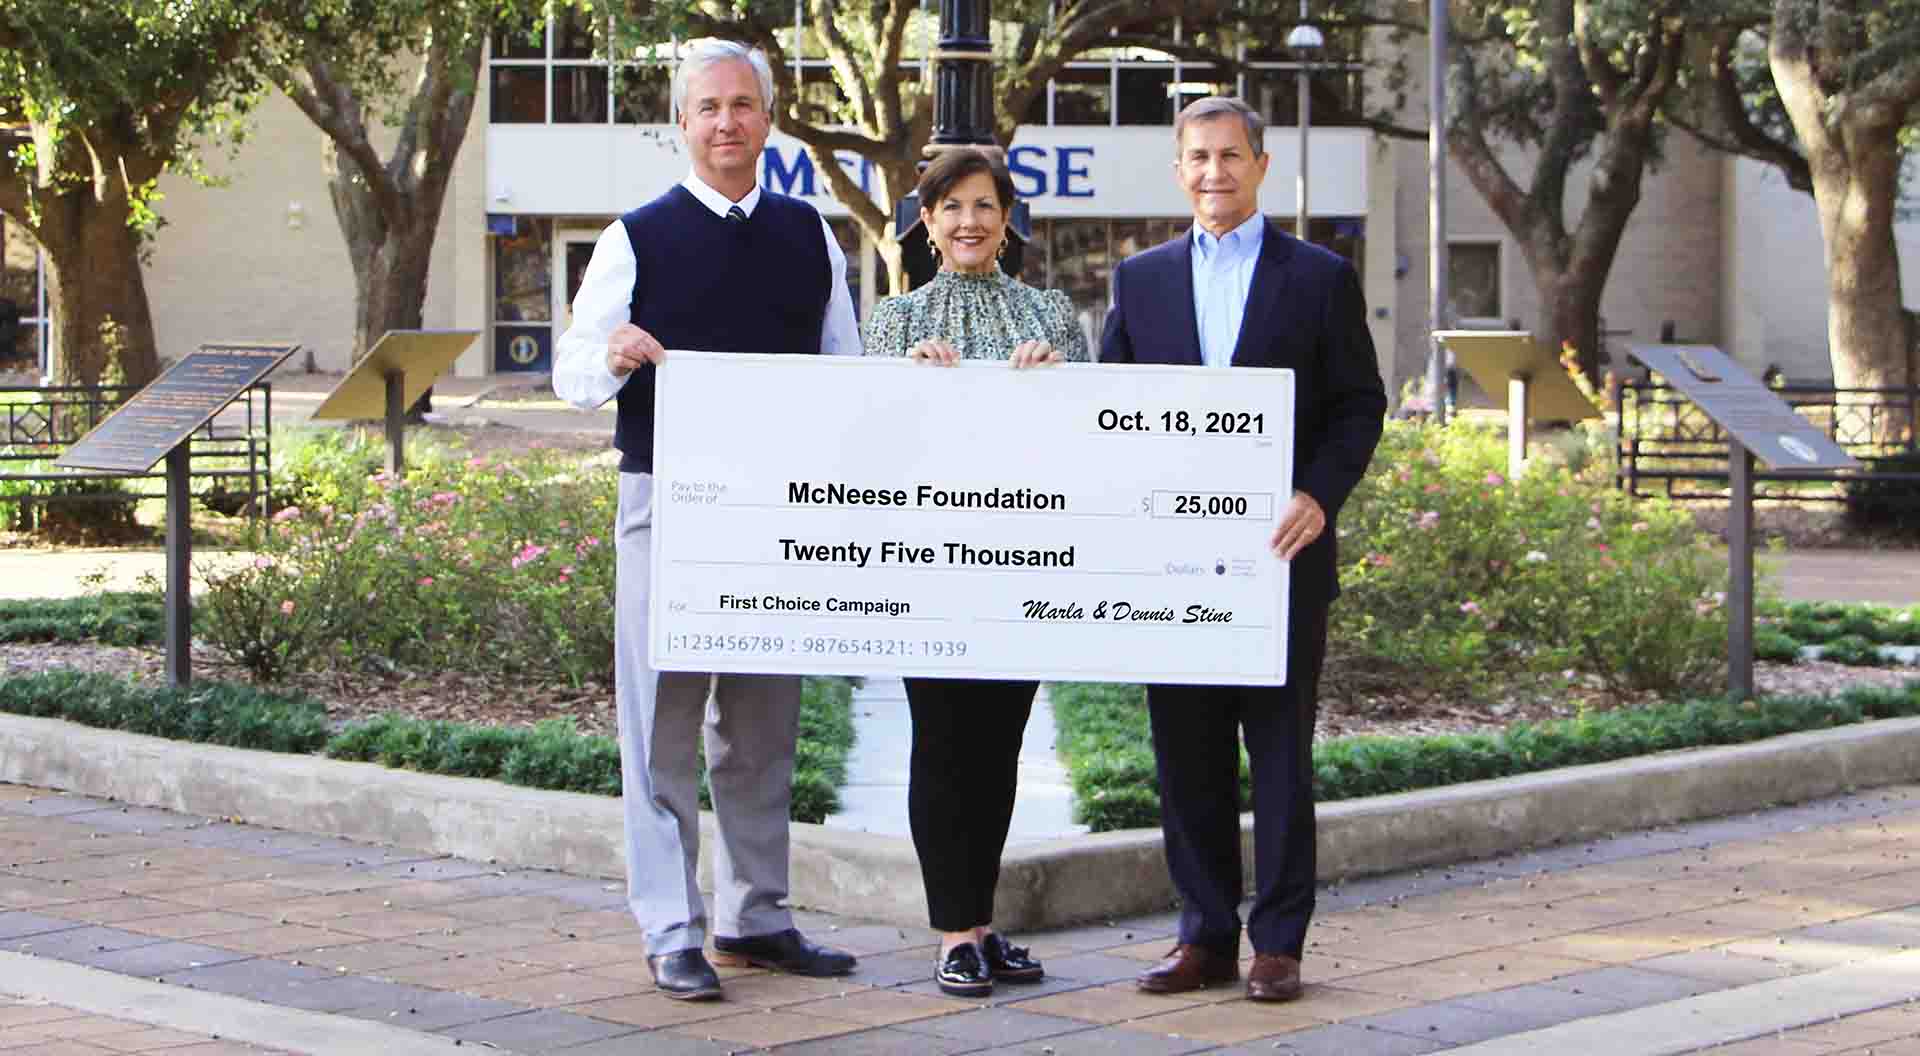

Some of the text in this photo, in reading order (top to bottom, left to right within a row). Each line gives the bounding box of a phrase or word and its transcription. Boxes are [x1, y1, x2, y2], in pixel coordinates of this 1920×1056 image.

[1097, 409, 1263, 436] Oct. 18, 2021
[788, 482, 1065, 510] McNeese Foundation
[1175, 495, 1247, 518] 25,000
[778, 539, 1075, 568] Twenty Five Thousand
[720, 594, 910, 617] First Choice Campaign
[1022, 599, 1233, 623] Marla & Dennis Stine
[923, 640, 968, 657] 1939
